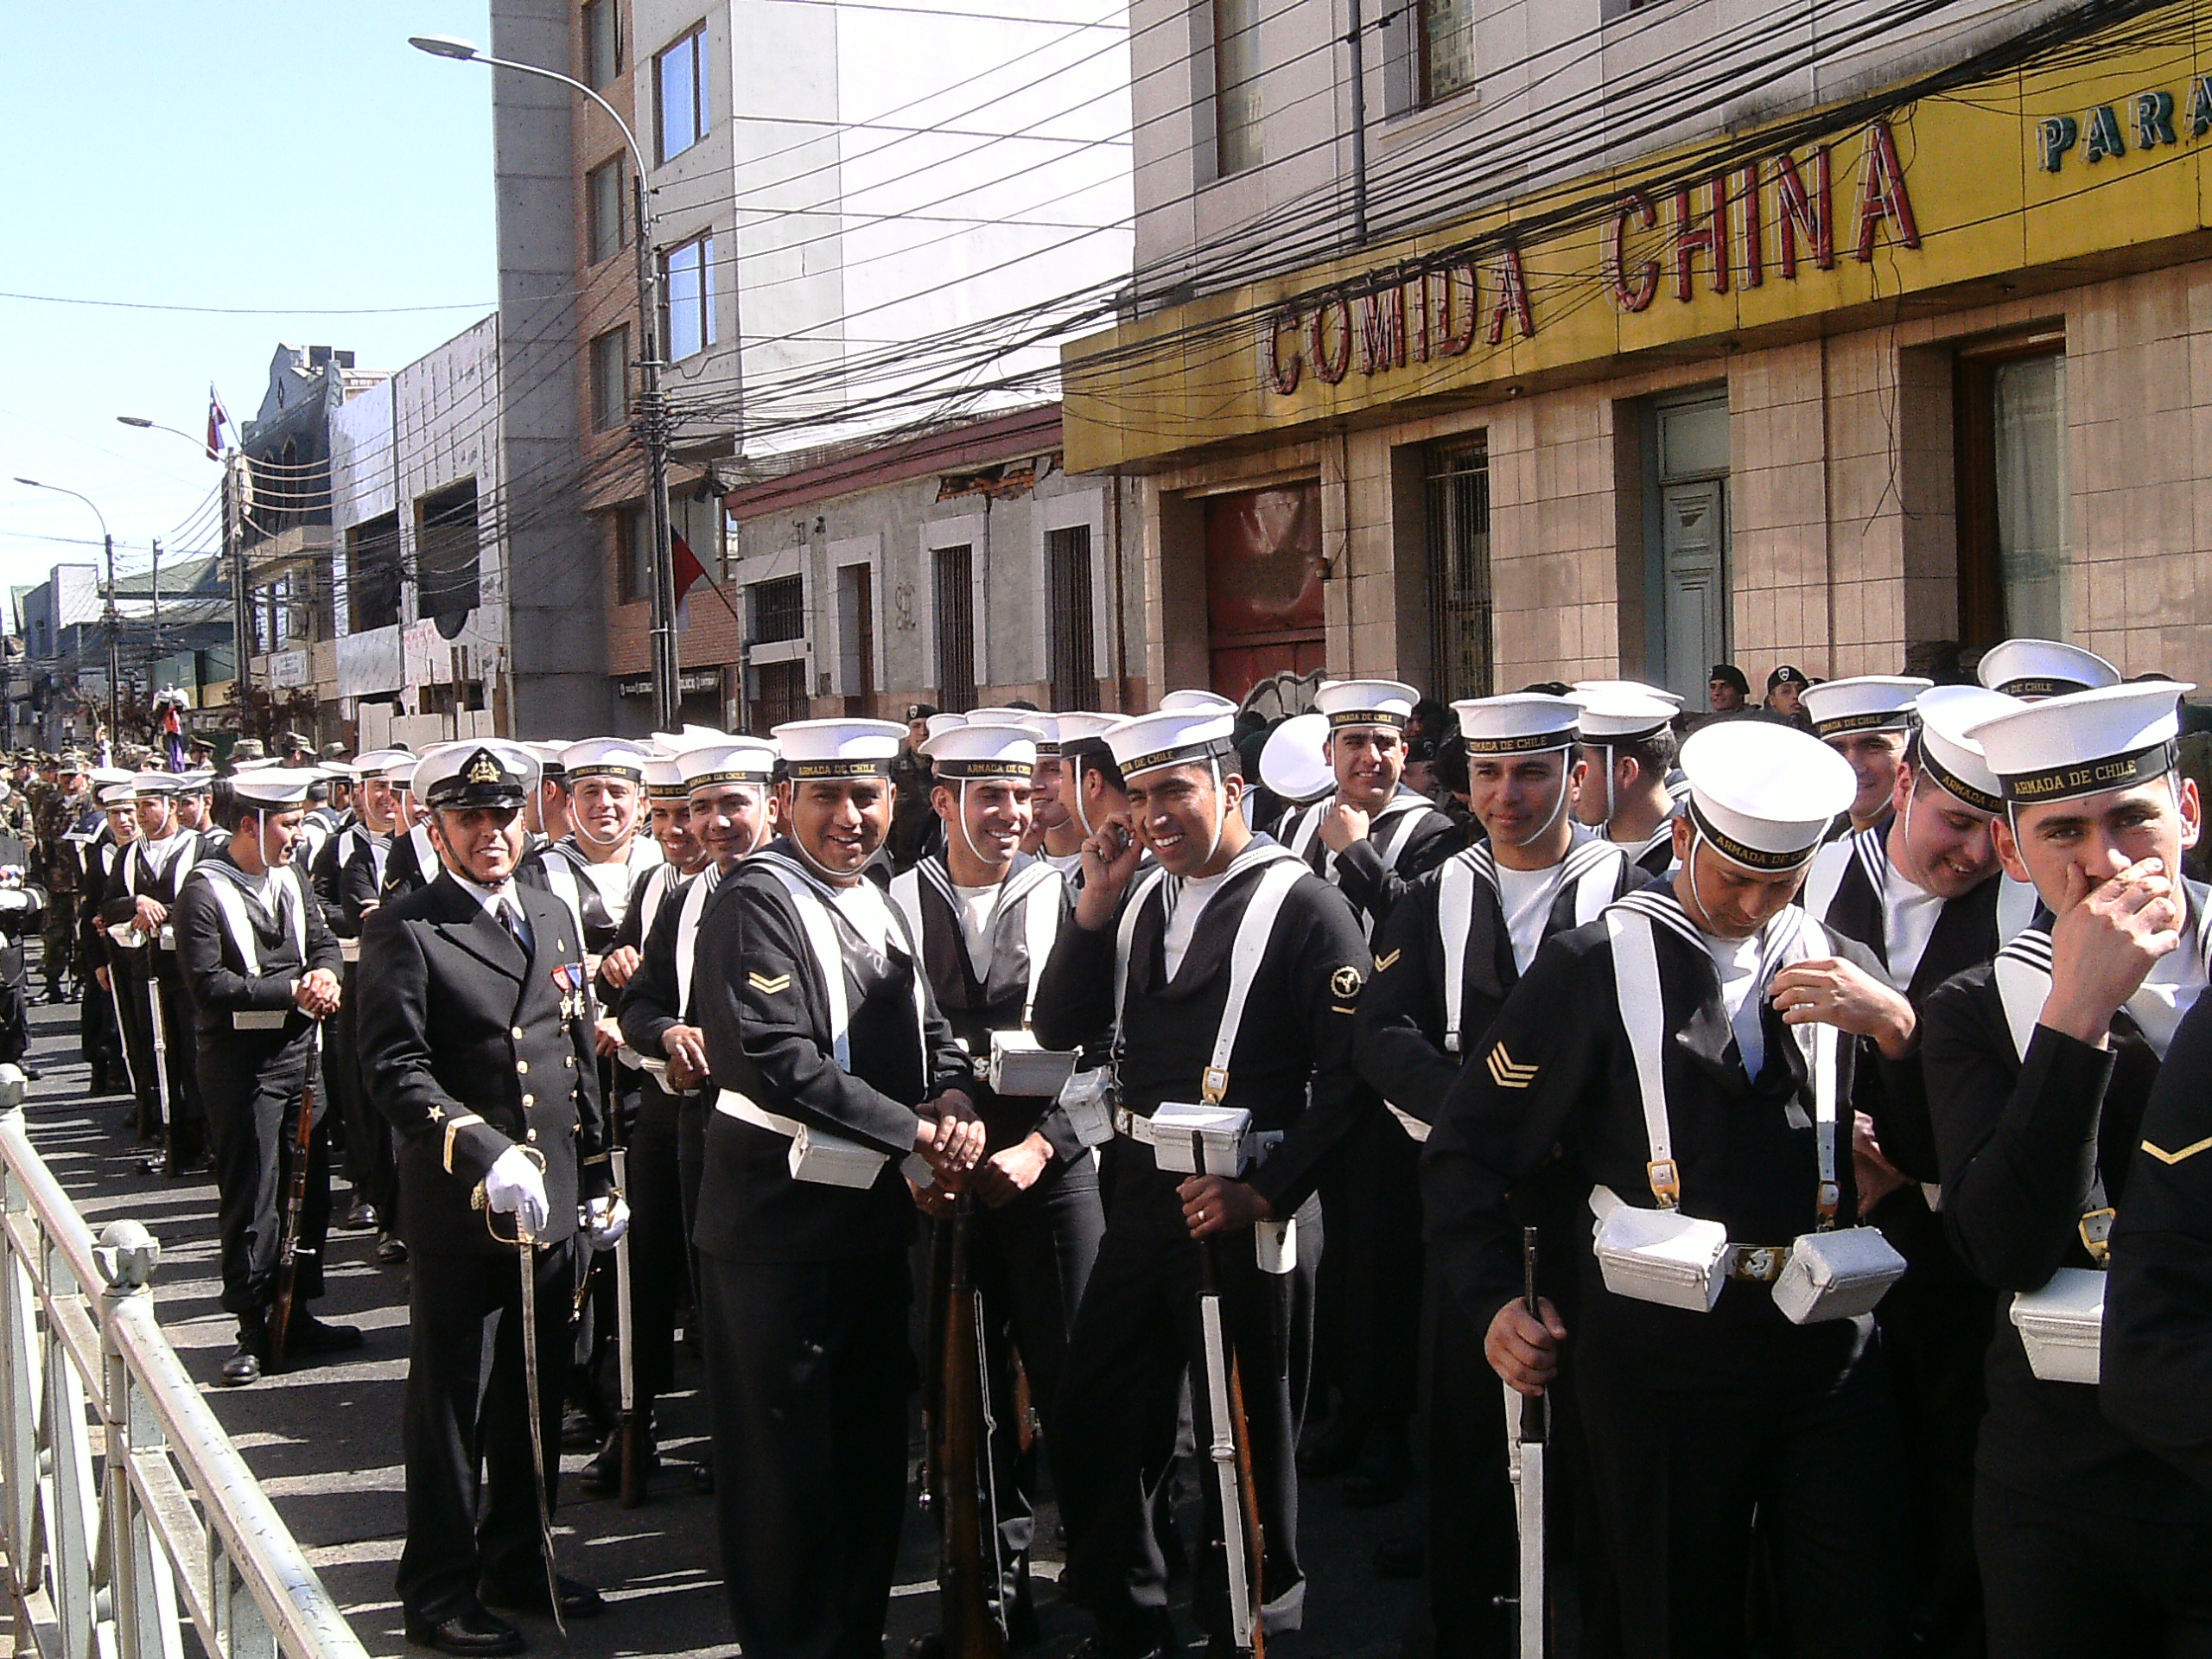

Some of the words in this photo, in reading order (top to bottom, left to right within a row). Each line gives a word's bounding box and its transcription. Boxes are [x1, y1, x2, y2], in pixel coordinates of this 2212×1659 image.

[2036, 73, 2212, 173] PARA
[1255, 245, 1535, 396] COMIDA
[1600, 121, 1920, 313] CHINA
[2011, 683, 2023, 694] DE
[2025, 683, 2052, 692] CHILE
[1500, 741, 1515, 750] DE
[1517, 736, 1547, 748] CHILE
[798, 766, 830, 776] ARMADA
[835, 765, 848, 774] DE
[850, 763, 876, 773] CHILE
[968, 764, 1004, 774] ARMADA
[1135, 758, 1147, 768] DE
[1147, 751, 1174, 764] CHILE
[2014, 774, 2065, 794] ARMADA
[2069, 769, 2092, 786] DE
[2095, 760, 2137, 780] CHILE
[1942, 775, 1986, 805] ARMADA
[1715, 834, 1767, 864] ARMADA
